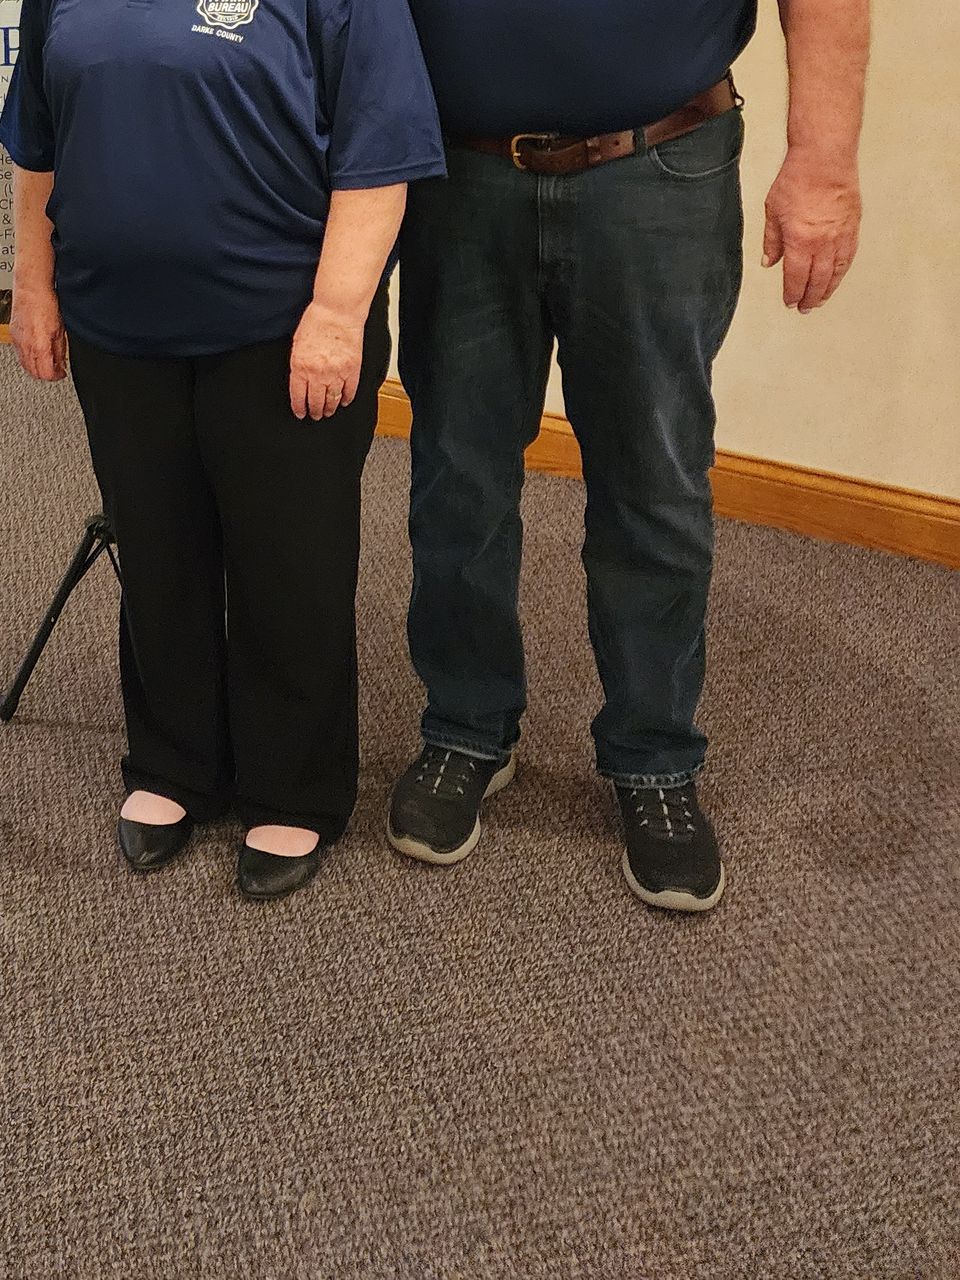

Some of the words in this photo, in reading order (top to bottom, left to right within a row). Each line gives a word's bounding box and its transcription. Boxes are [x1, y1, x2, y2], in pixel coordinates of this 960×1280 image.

[208, 2, 248, 13] BUREAU
[191, 24, 215, 35] DARKE
[216, 29, 244, 43] COUNTY
[2, 213, 12, 225] &
